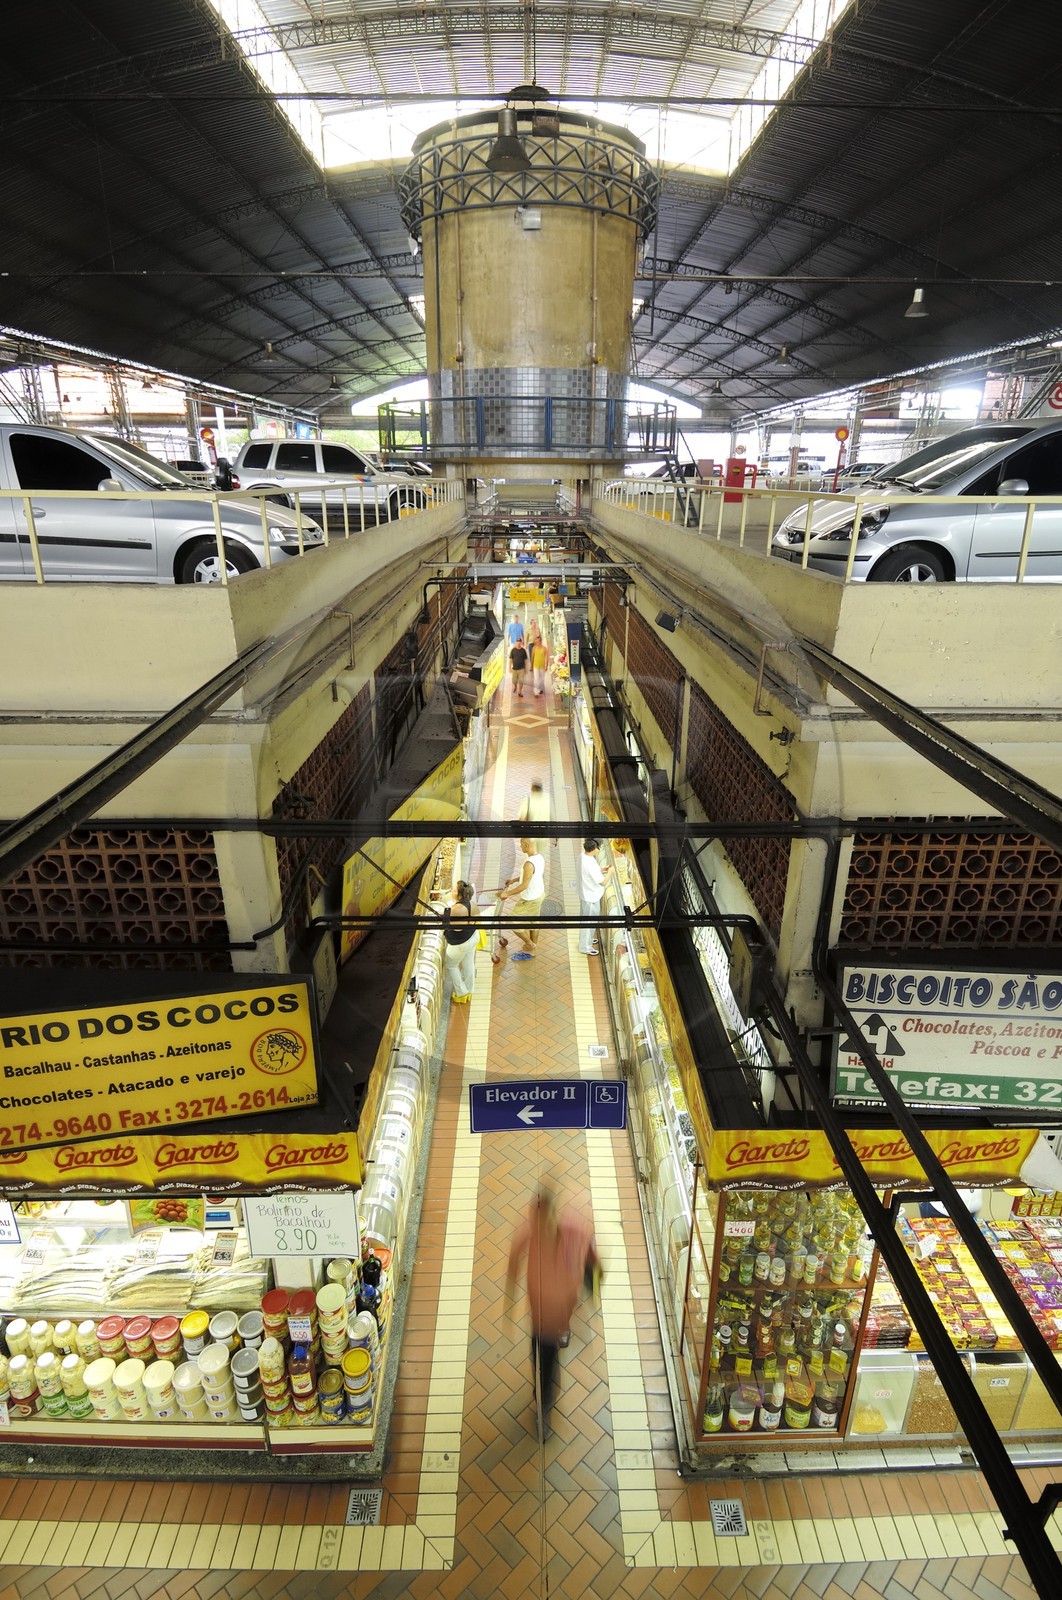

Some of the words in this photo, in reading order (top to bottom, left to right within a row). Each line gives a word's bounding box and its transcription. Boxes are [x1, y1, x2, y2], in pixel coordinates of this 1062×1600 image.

[431, 751, 461, 791] COCOS
[845, 973, 993, 1008] BISCOITO
[997, 974, 1062, 1011] SÃO
[1, 1021, 70, 1048] RIO
[78, 1010, 160, 1040] DOS
[167, 993, 299, 1028] COCOS
[902, 1017, 997, 1038] Chocolates,
[4, 1061, 71, 1078] Bacalhau
[83, 1050, 156, 1068] Castanhas
[166, 1040, 232, 1058] Azeitonas
[970, 1040, 1032, 1056] Páscoa
[1036, 1048, 1047, 1059] e
[0, 1089, 94, 1109] Chocolates
[108, 1076, 174, 1095] Atacado
[180, 1075, 190, 1084] e
[196, 1066, 246, 1083] varejo
[486, 1086, 557, 1102] Elevador
[563, 1087, 576, 1100] II
[1013, 1081, 1062, 1103] 32
[0, 1113, 112, 1146] 274-9640
[175, 1086, 289, 1120] 3274-2614
[289, 1095, 305, 1104] Loja
[54, 1144, 138, 1173] Garoto
[154, 1141, 239, 1172] Garoto
[264, 1142, 349, 1174] Garoto
[725, 1138, 811, 1171] Garoto
[938, 1137, 1020, 1168] Garoto
[59, 1183, 76, 1194] Mais
[77, 1183, 99, 1191] prazer
[158, 1182, 175, 1191] Mais
[176, 1182, 198, 1190] prazer
[265, 1184, 283, 1193] Mais
[722, 1182, 740, 1192] Mais
[828, 1182, 845, 1192] Mais
[256, 1204, 302, 1217] Bolinho
[311, 1205, 325, 1218] de
[273, 1216, 331, 1228] Bacalhau
